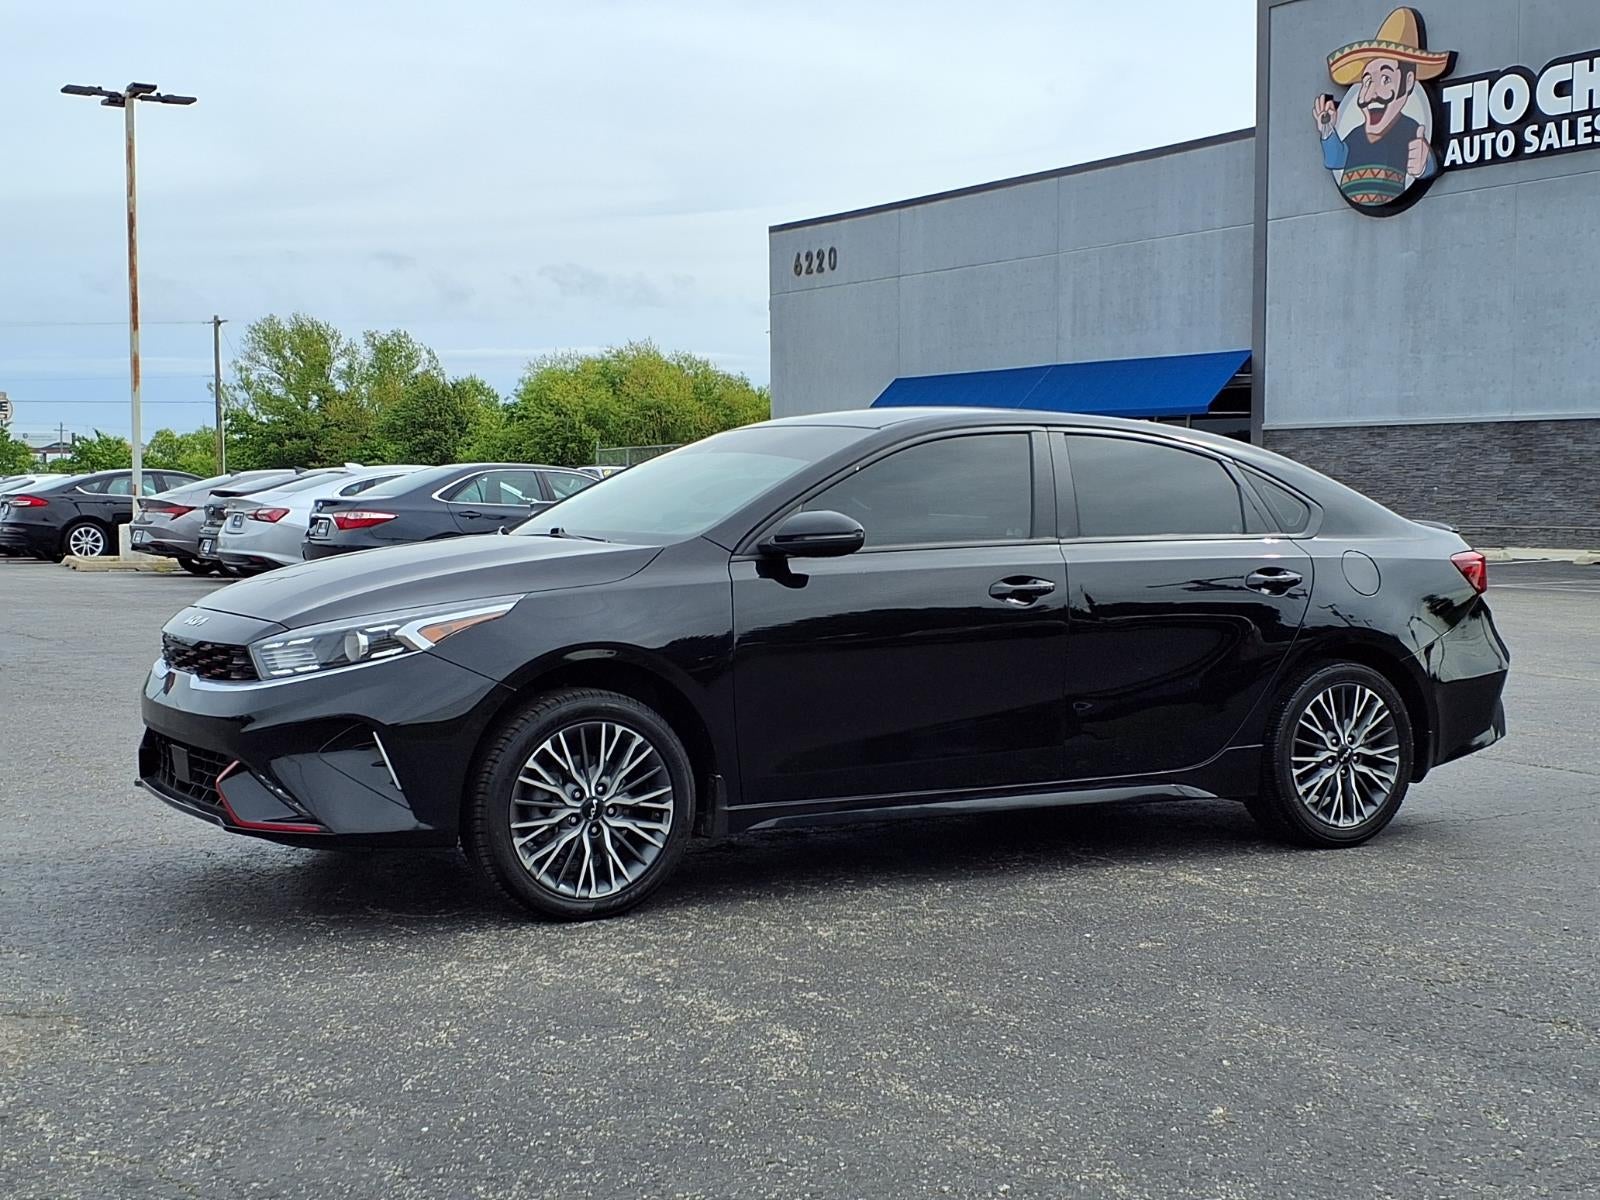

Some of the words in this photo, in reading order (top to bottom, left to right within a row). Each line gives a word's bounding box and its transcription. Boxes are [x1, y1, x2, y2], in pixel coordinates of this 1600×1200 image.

[1442, 73, 1530, 134] TIO
[1536, 57, 1600, 116] CH
[1443, 129, 1516, 167] AUTO
[793, 246, 837, 276] 6220
